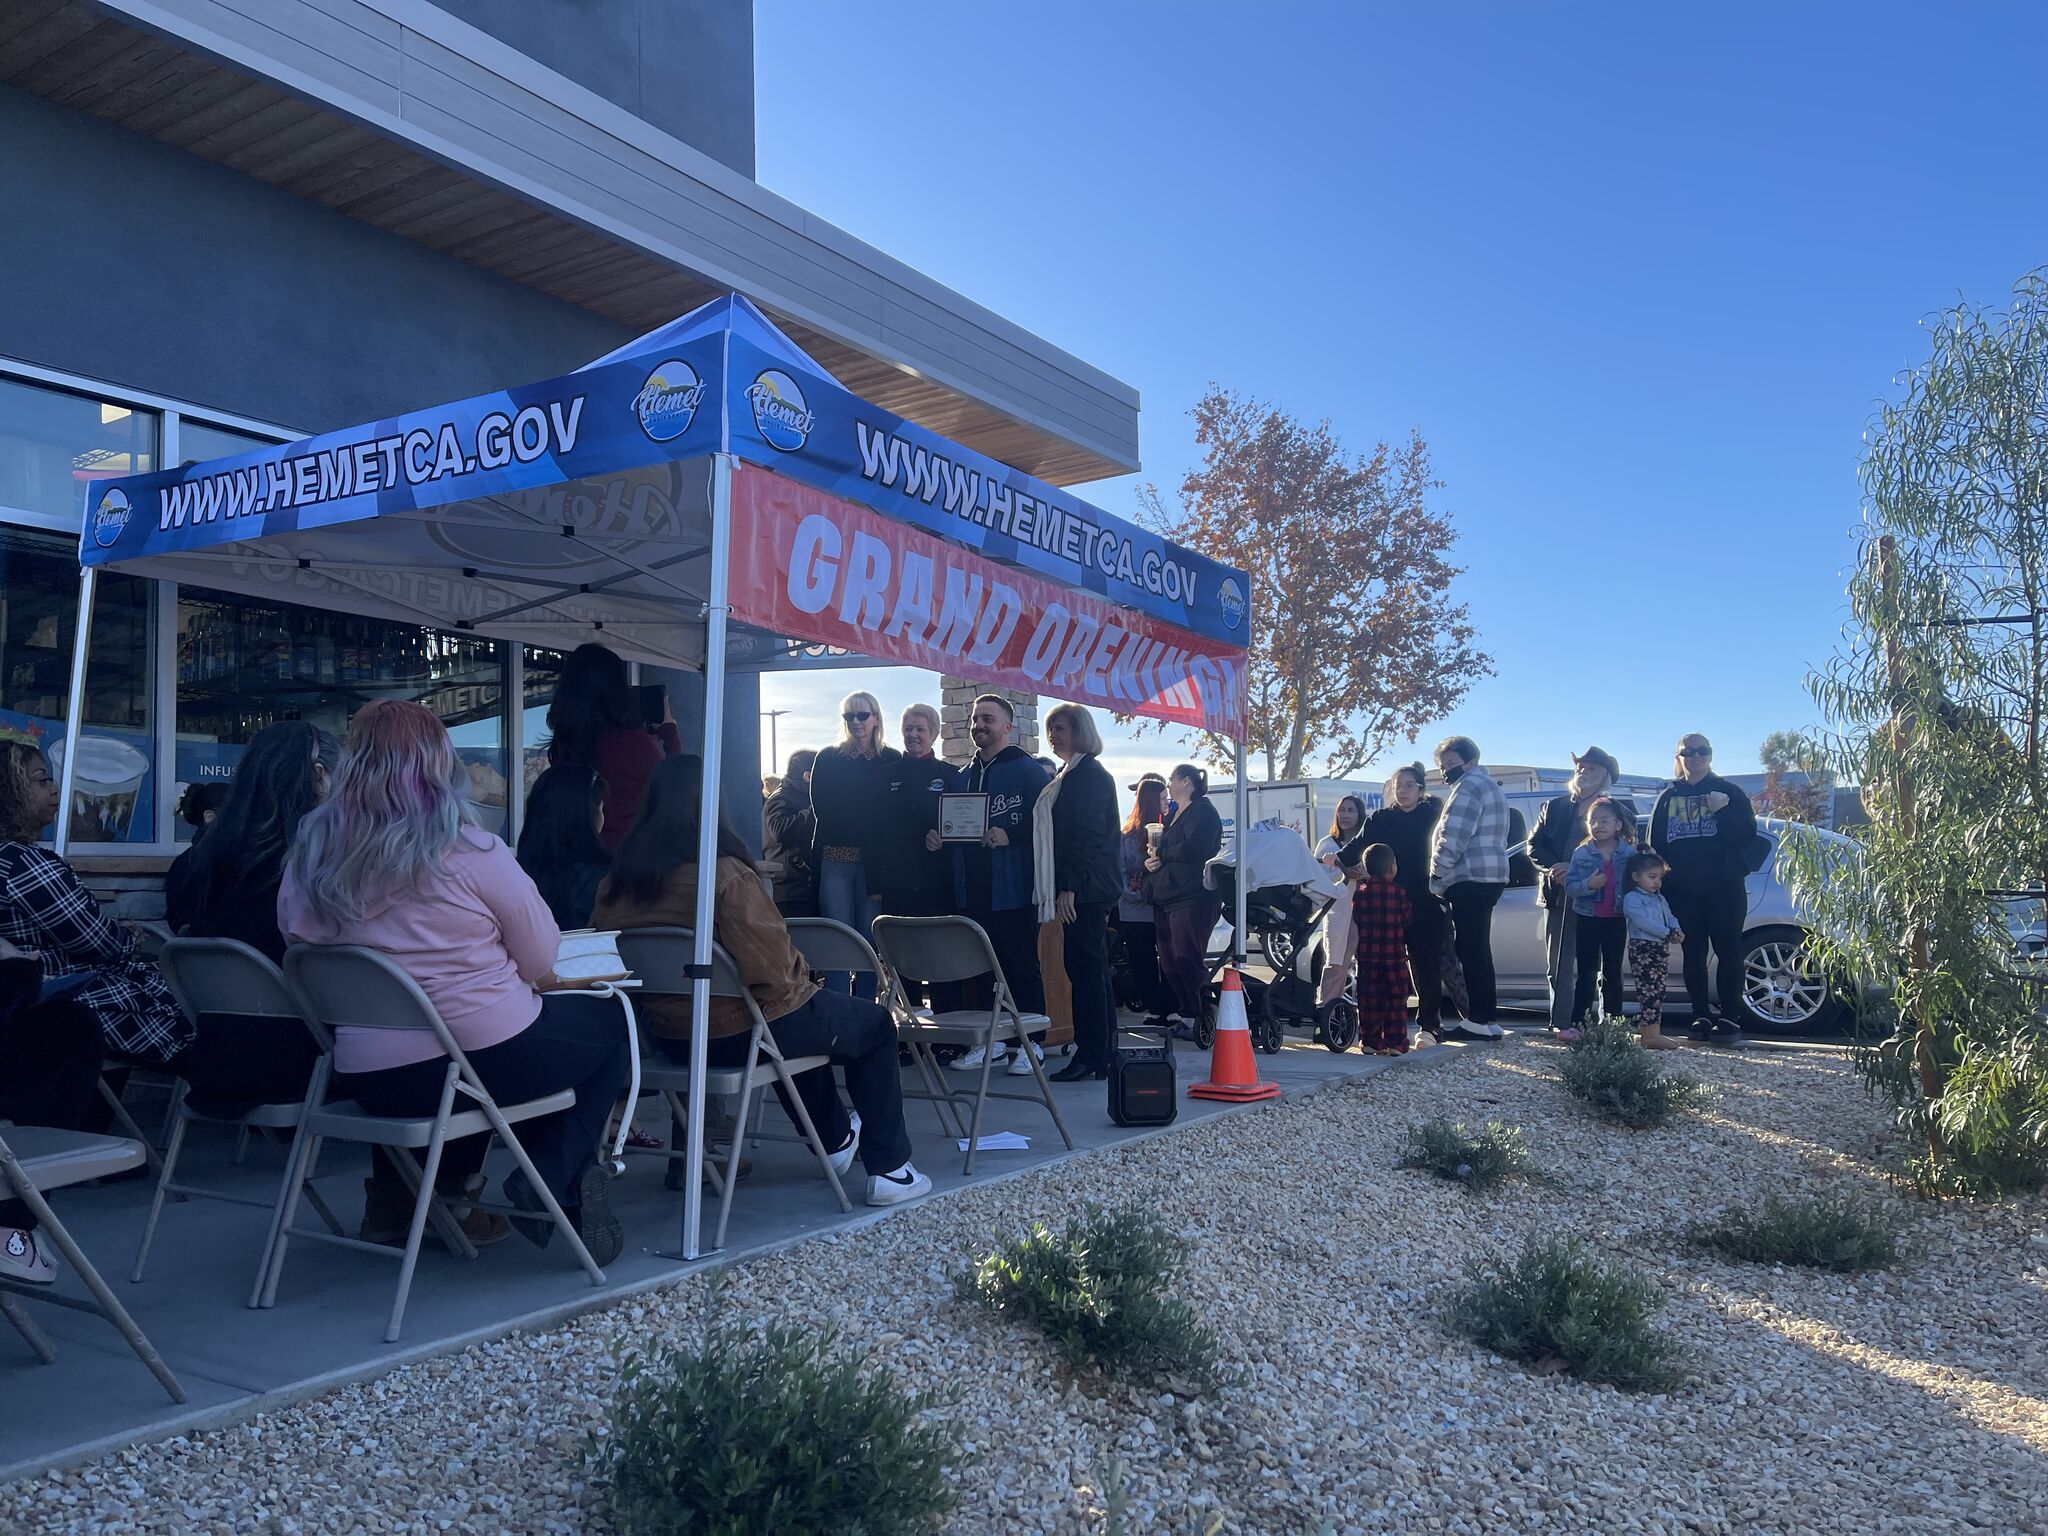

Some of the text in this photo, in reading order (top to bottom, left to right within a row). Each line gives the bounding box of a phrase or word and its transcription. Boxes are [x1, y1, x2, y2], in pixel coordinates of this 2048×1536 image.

[630, 379, 707, 419] Hemet
[743, 383, 816, 433] Hemet
[159, 396, 585, 531] WWW.HEMETCA.GOV
[92, 503, 134, 528] Hemet
[856, 421, 1198, 607] WWW.HEMETCA.GOV
[787, 513, 1236, 720] GRAND OPENING!
